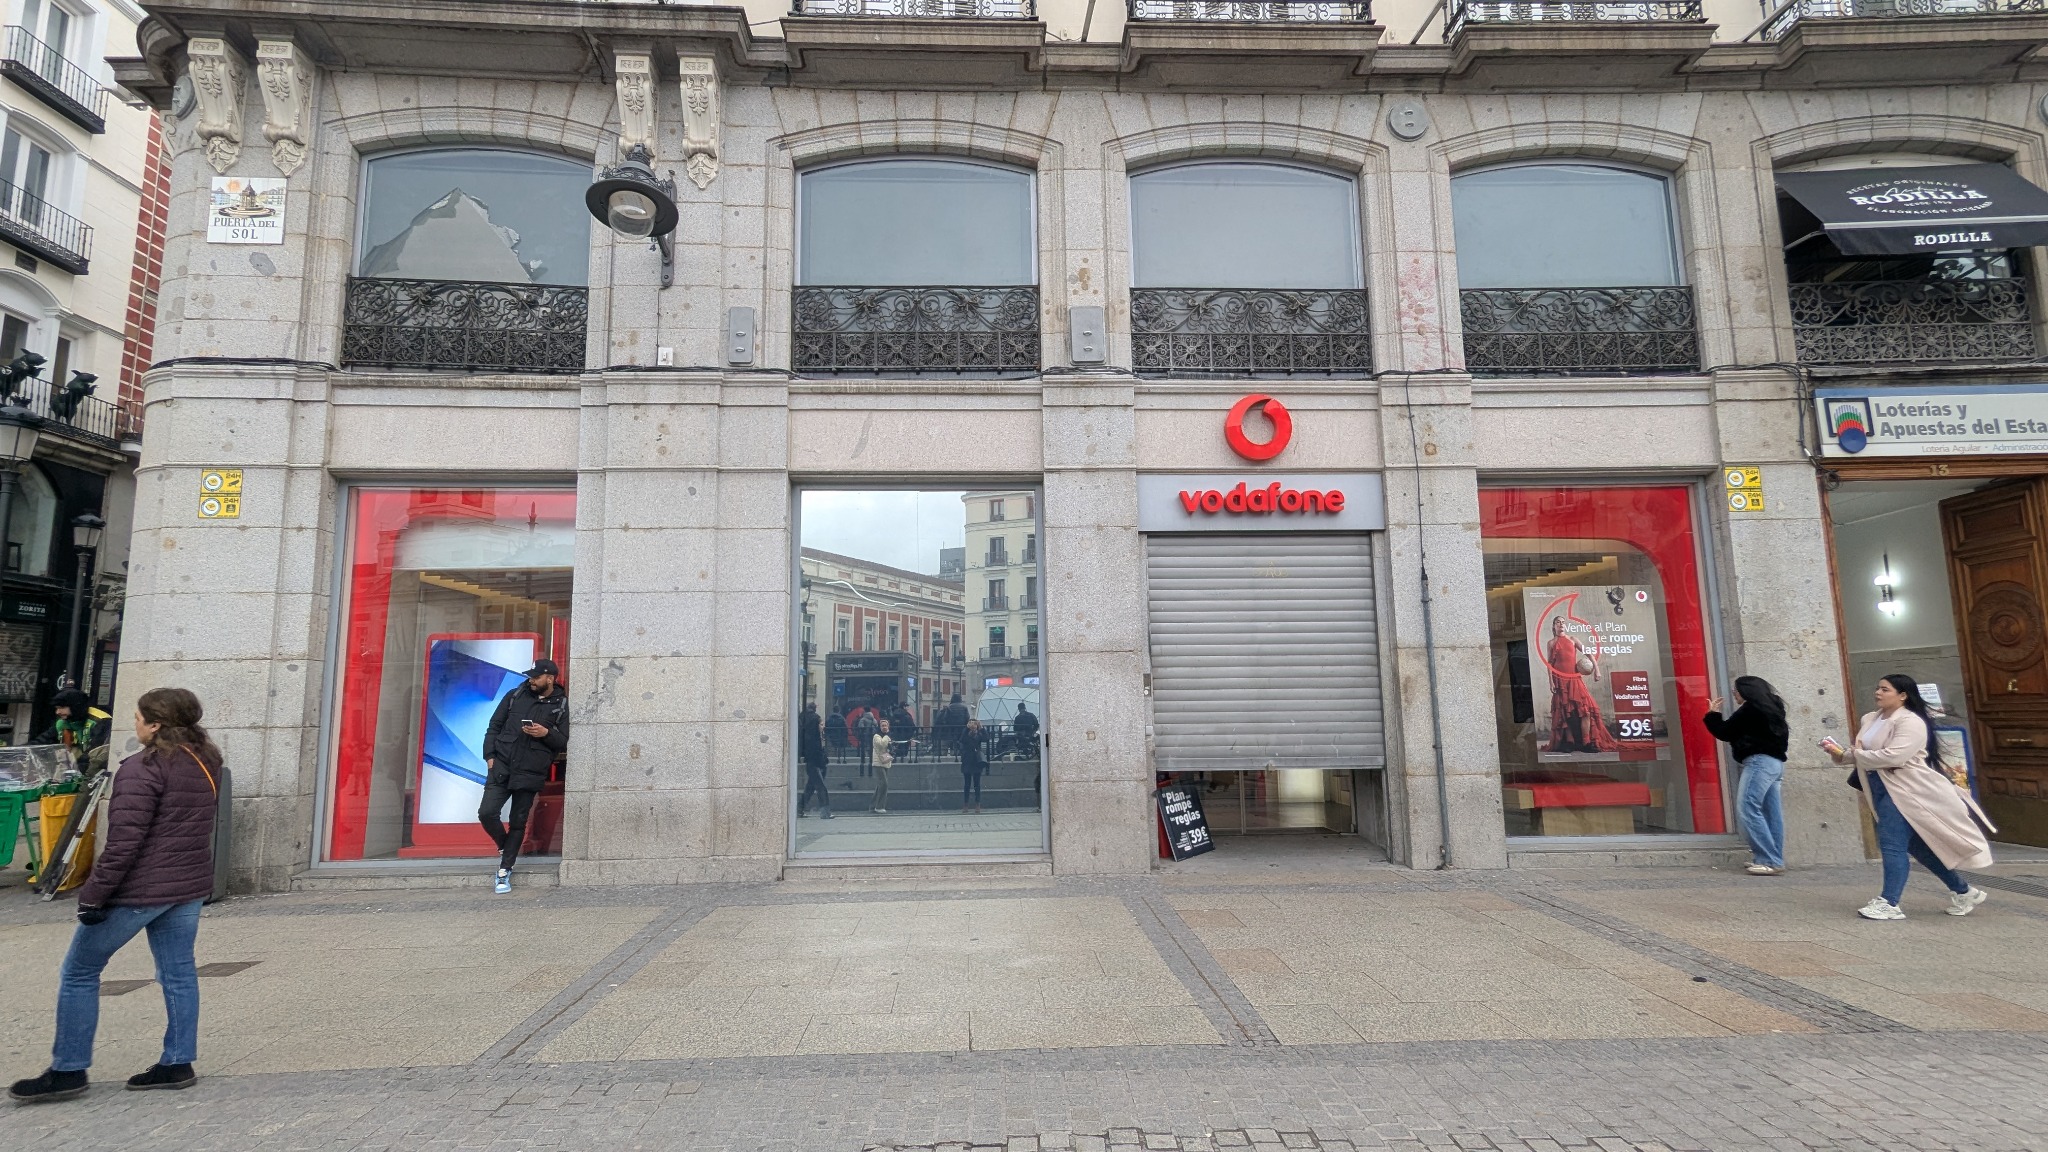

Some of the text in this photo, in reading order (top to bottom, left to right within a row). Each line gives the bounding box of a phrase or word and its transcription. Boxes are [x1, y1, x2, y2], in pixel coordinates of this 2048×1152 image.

[1849, 190, 1988, 205] RODILLA
[213, 217, 278, 228] PUERTA DEL
[232, 228, 258, 240] SOL
[1914, 231, 1992, 246] RODILLA
[1874, 400, 1968, 420] Loterías y
[1880, 418, 2048, 440] Apuestas del Esta
[1930, 464, 1950, 477] 13
[1179, 481, 1345, 515] vodafone
[1565, 622, 1627, 633] Vente al Plan
[1588, 633, 1644, 645] que rompe
[1582, 644, 1633, 656] las reglas
[1619, 719, 1652, 737] 39€
[1166, 791, 1185, 803] Plan
[1165, 800, 1193, 815] rompe
[1174, 810, 1201, 825] reglas
[1188, 826, 1208, 843] 39€
